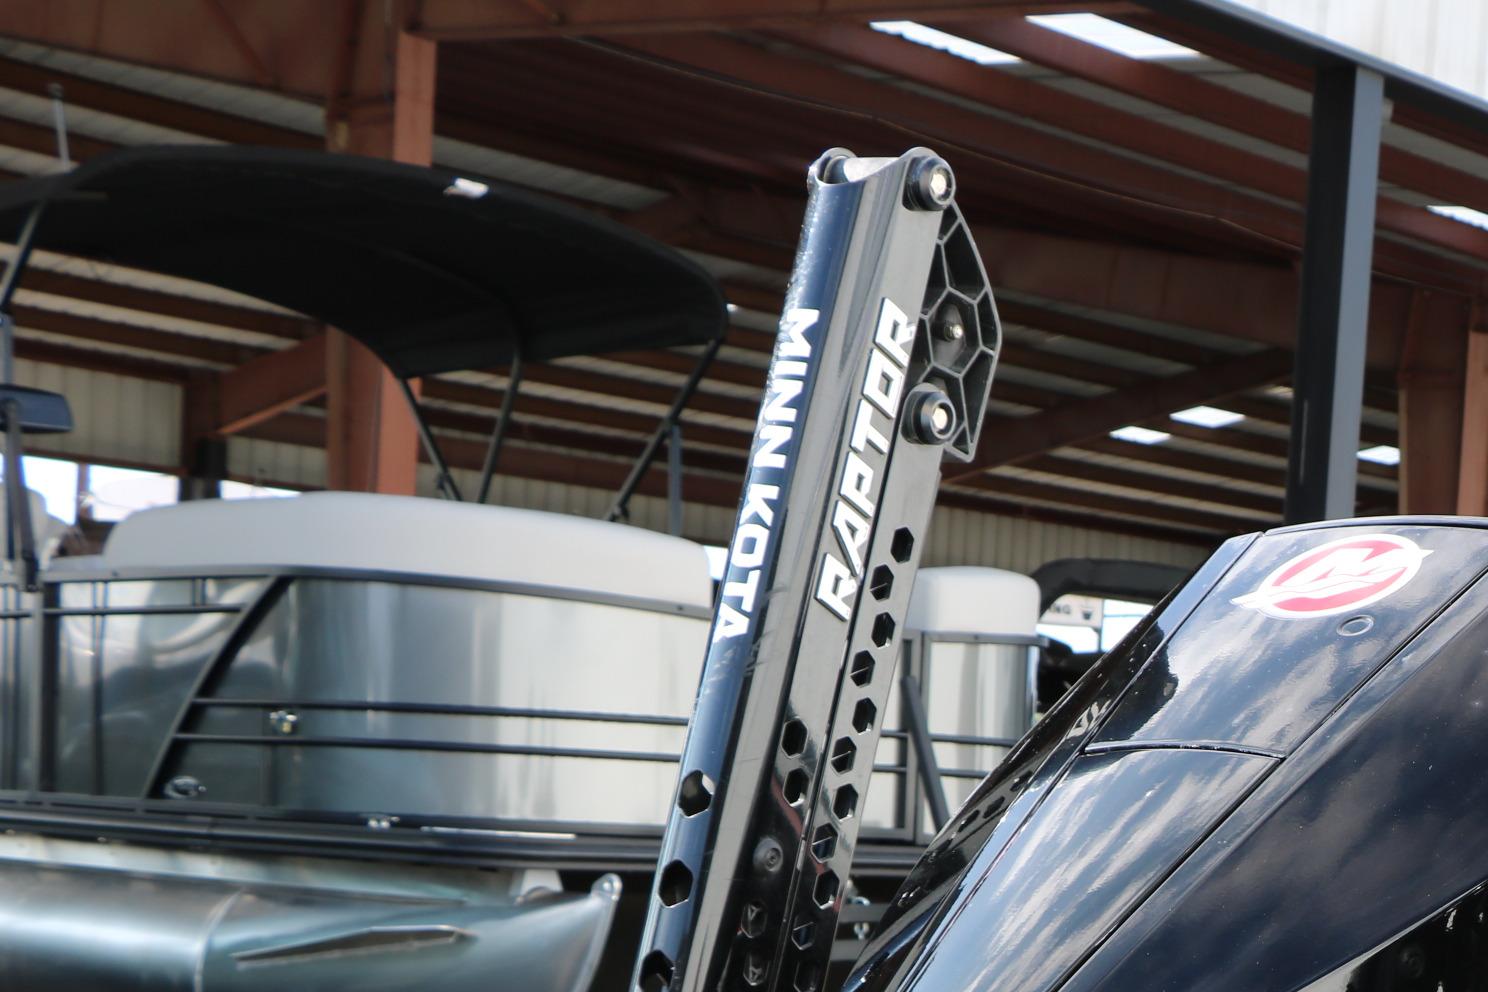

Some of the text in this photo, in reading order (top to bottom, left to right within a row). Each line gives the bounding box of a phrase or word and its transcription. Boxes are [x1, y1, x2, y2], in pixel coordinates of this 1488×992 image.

[711, 308, 820, 643] MINN KOTA
[815, 297, 915, 621] RAPTOR
